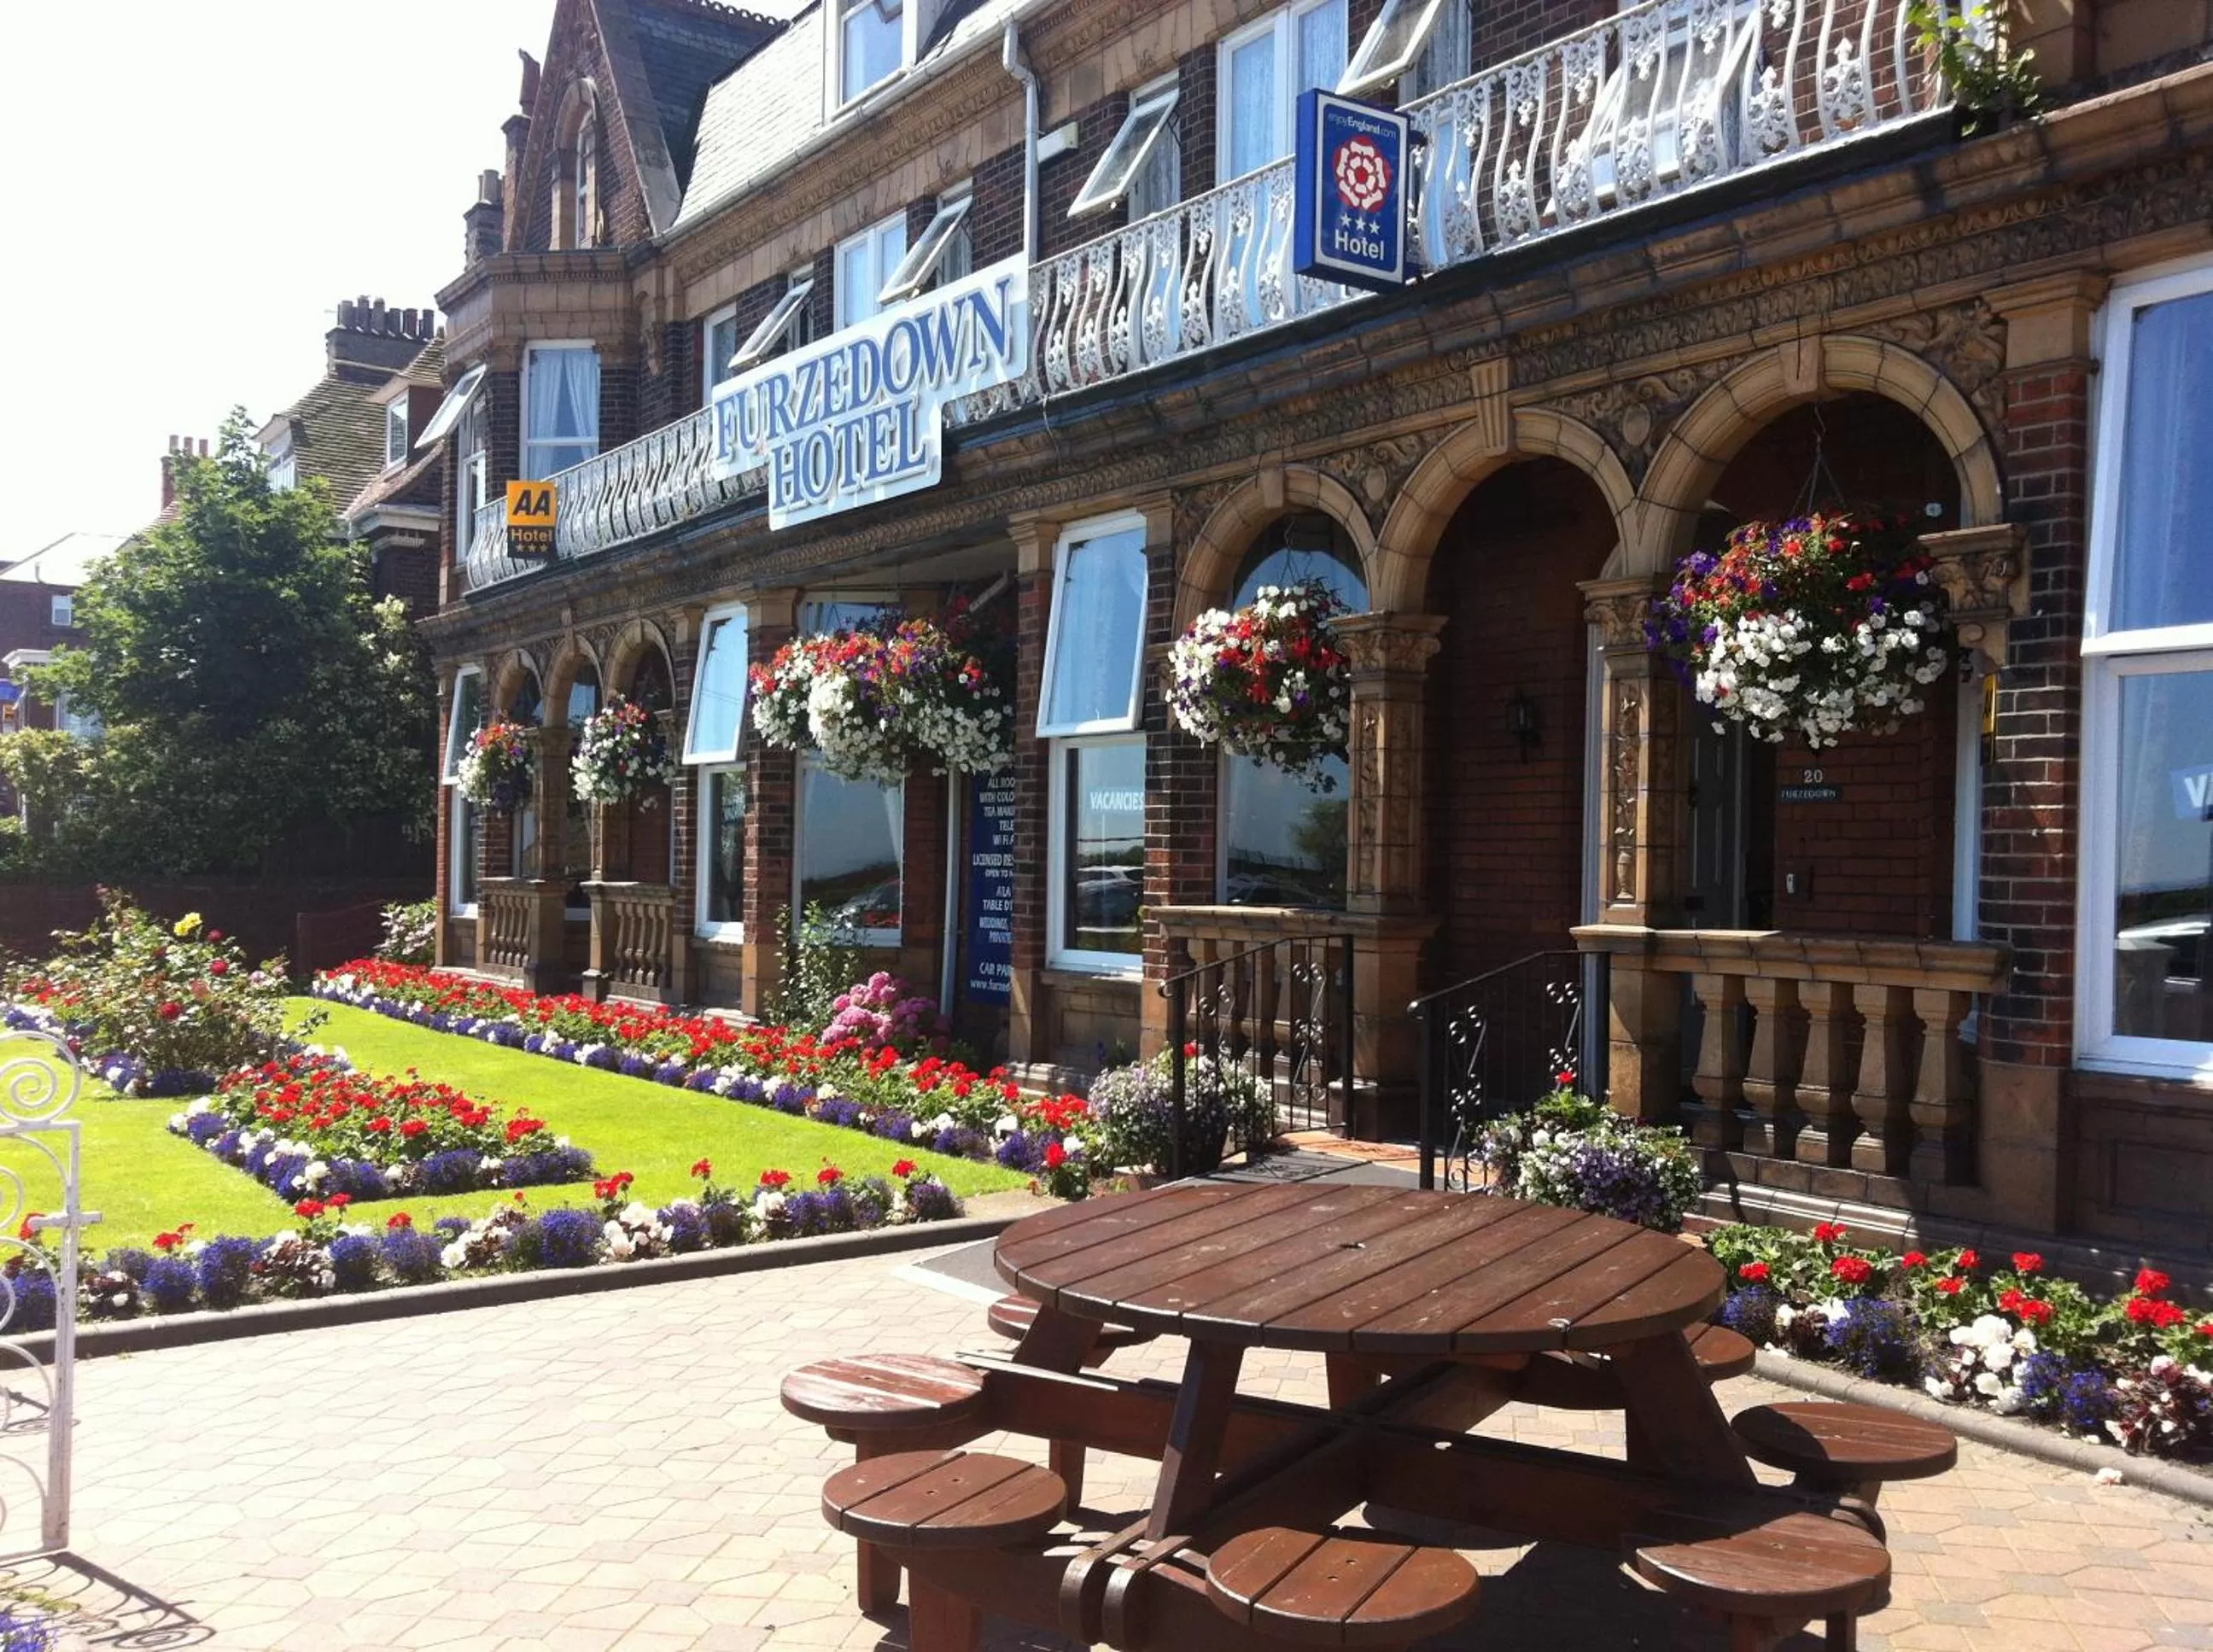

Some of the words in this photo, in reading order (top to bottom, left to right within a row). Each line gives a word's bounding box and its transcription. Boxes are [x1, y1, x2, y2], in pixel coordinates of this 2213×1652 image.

[1334, 229, 1385, 260] Hotel
[715, 278, 1011, 461] FURZEDOWN
[771, 400, 927, 510] HOTEL
[512, 489, 550, 516] AA
[511, 528, 552, 542] Hotel
[1803, 769, 1823, 783] 20
[1089, 791, 1144, 810] VACANCIES
